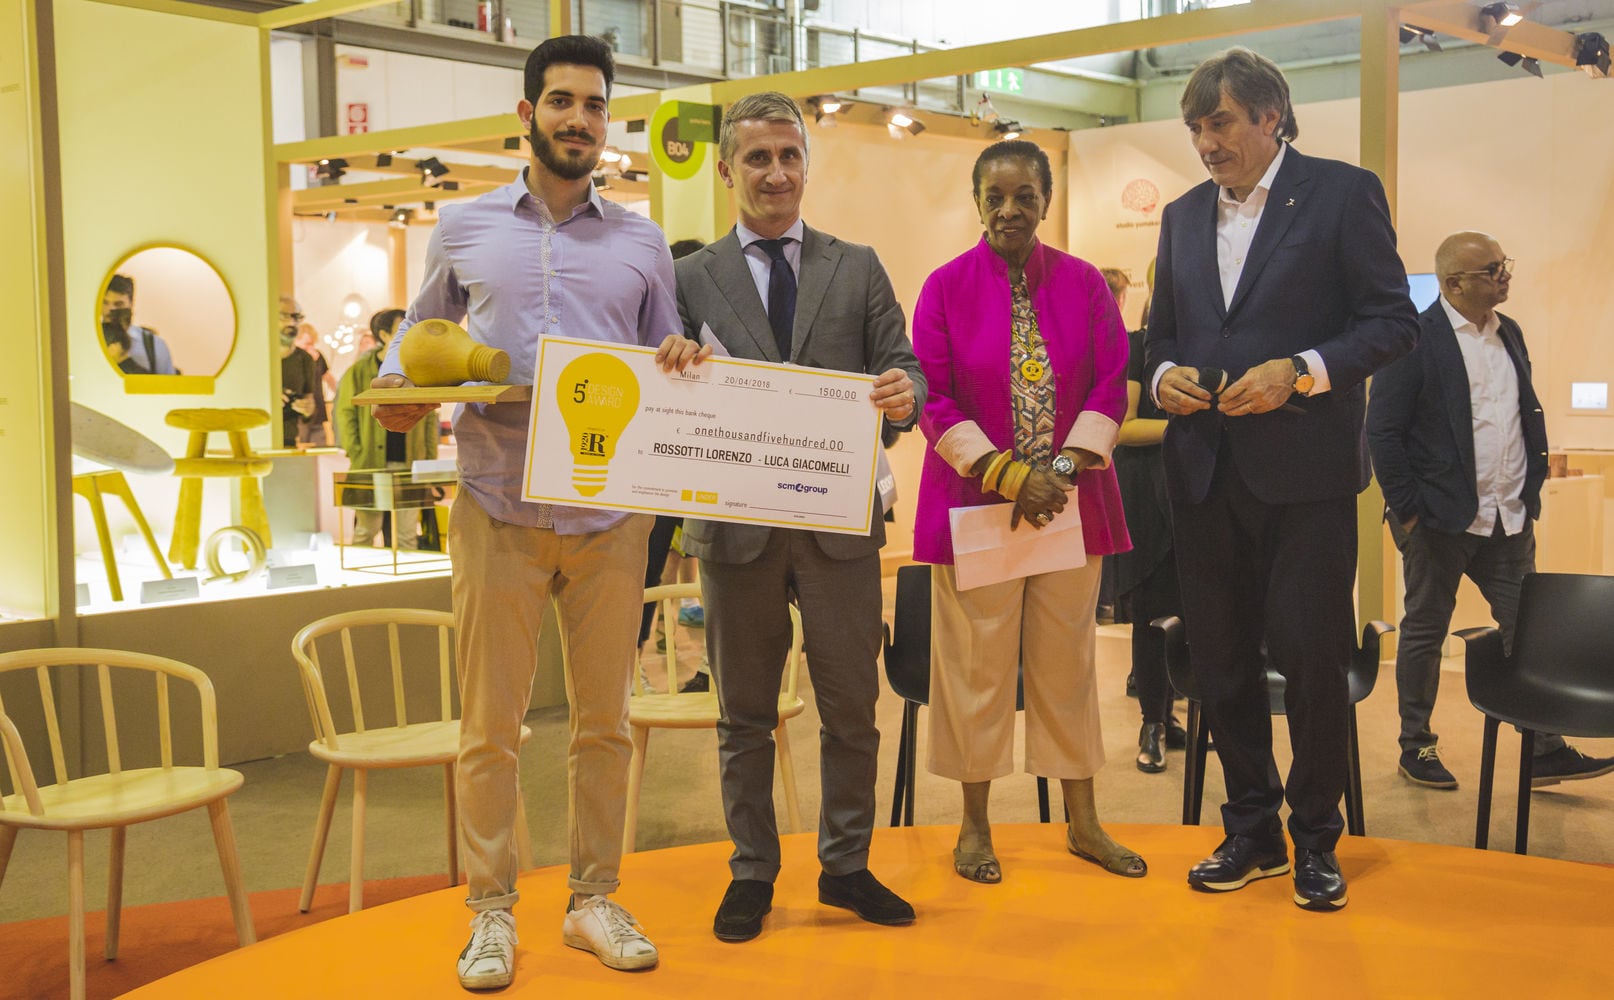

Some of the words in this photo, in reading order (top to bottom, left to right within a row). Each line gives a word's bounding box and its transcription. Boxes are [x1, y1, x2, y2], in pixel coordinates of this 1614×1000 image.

[667, 141, 689, 157] B04
[679, 370, 701, 380] Milan
[818, 387, 857, 400] 1500,00
[645, 406, 654, 414] pay
[662, 407, 674, 415] sight
[685, 409, 697, 417] bank
[580, 432, 589, 451] 1920
[589, 432, 606, 454] R
[694, 425, 844, 451] onethousandfivehundred,00
[653, 442, 704, 459] ROSSOTTI
[705, 448, 753, 464] LORENZO
[764, 455, 790, 468] LUCA
[792, 458, 850, 474] GIACOMELLI
[724, 499, 748, 509] signature
